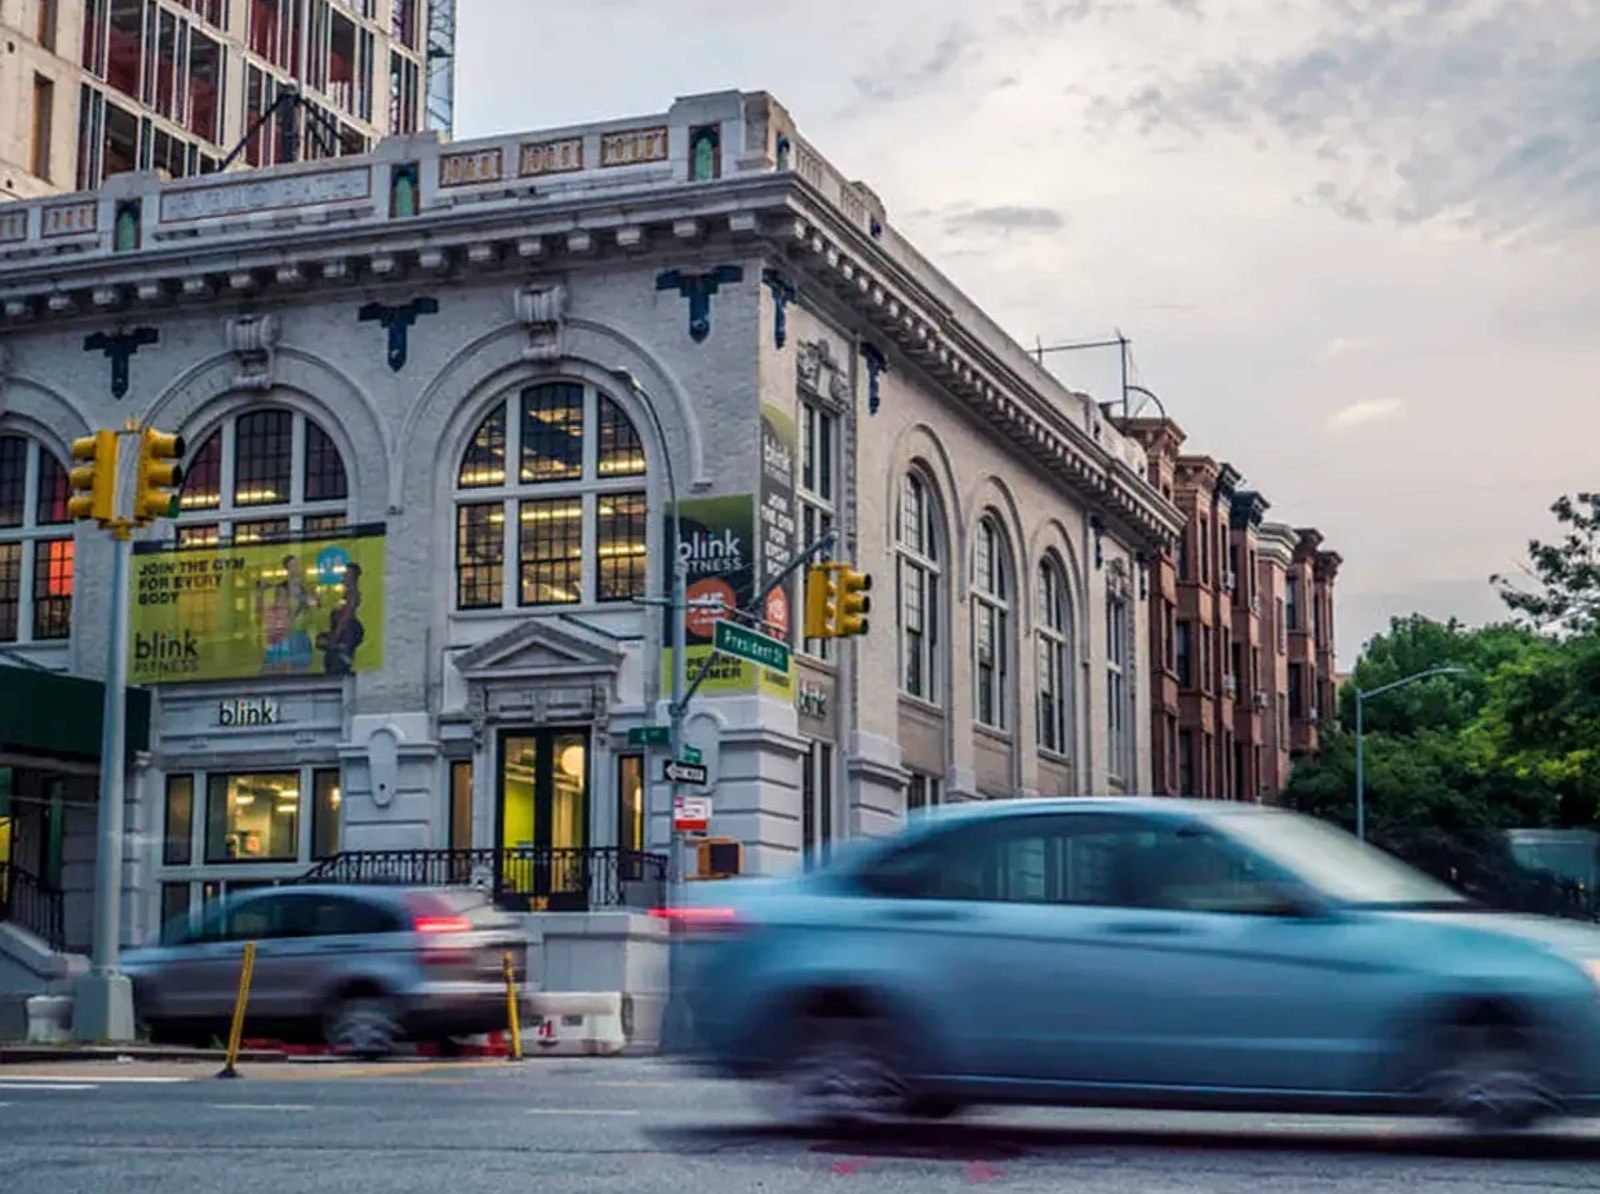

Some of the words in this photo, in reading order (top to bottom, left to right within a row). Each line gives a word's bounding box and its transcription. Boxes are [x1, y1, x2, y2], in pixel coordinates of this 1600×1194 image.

[138, 562, 175, 576] JOIN
[180, 559, 209, 574] THE
[213, 556, 245, 572] GYM
[138, 576, 169, 591] FOR
[173, 573, 222, 590] EVERY
[138, 591, 179, 606] BODY
[135, 630, 198, 659] blink
[724, 628, 773, 660] President
[219, 699, 273, 727] blink
